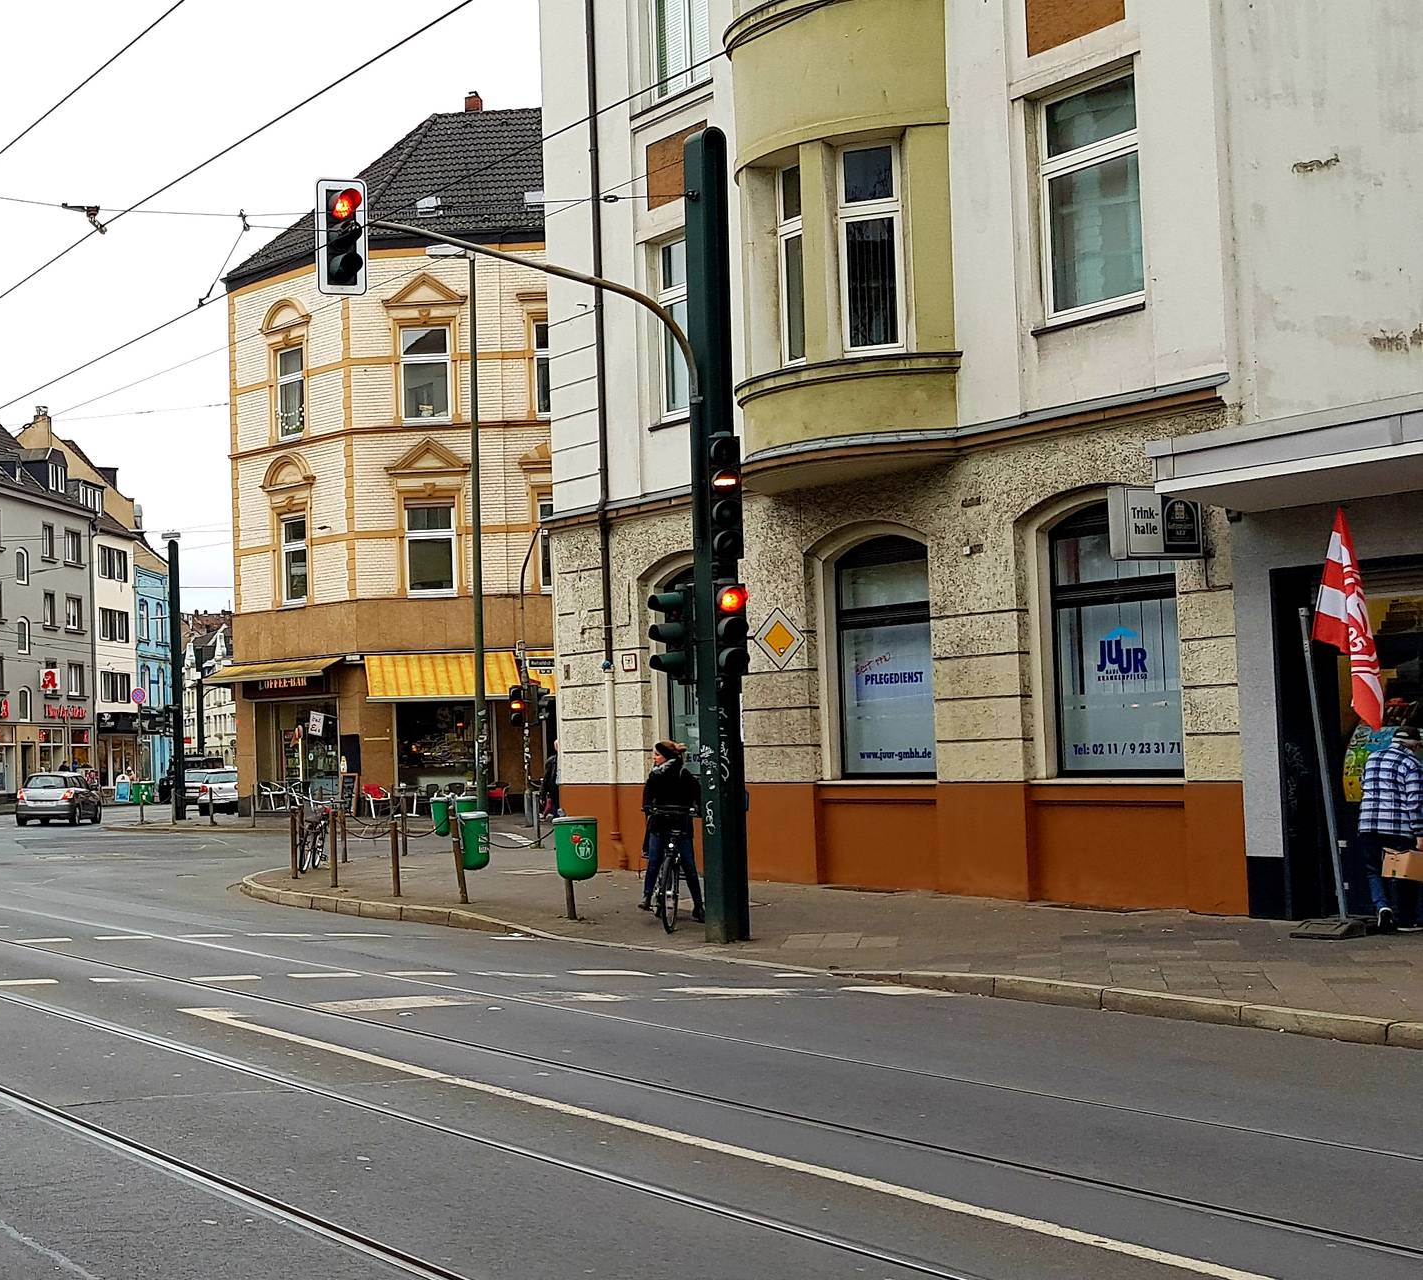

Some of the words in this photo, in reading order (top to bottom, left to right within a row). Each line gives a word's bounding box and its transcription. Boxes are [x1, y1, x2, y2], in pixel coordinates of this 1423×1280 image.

[1131, 506, 1160, 520] Trink-
[1134, 523, 1159, 535] halle
[1097, 639, 1149, 675] JUUR
[864, 671, 924, 686] PFLEGEDIENST
[859, 748, 933, 762] www.juur-gmbh.de
[1092, 743, 1105, 755] 02
[1108, 743, 1118, 755] 11
[1129, 743, 1136, 754] 9
[1138, 743, 1151, 754] 23
[1154, 742, 1165, 754] 31
[1170, 742, 1181, 753] 71
